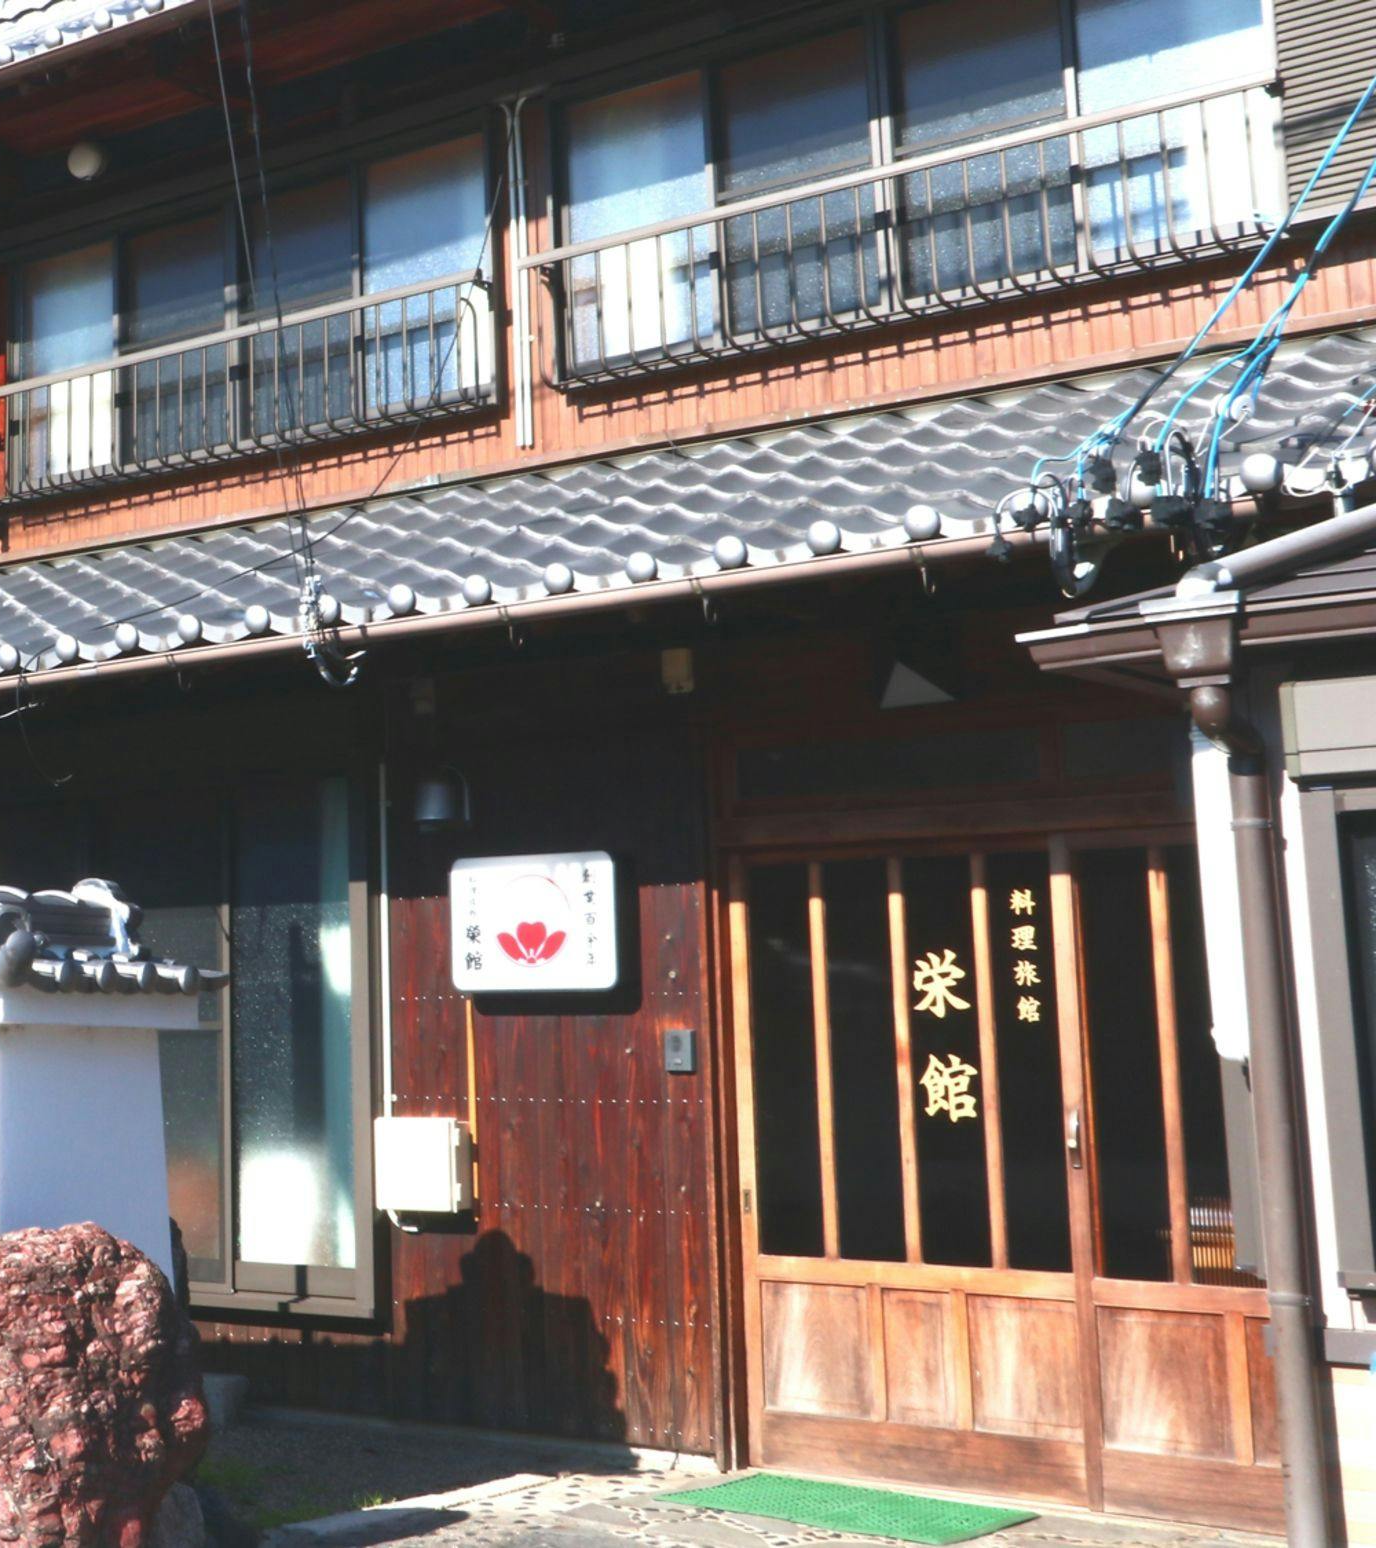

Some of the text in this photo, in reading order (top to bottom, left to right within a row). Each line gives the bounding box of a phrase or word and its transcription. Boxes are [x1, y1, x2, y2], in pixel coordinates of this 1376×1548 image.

[1009, 888, 1042, 1023] 料理旅館
[912, 948, 979, 1124] 栄館
